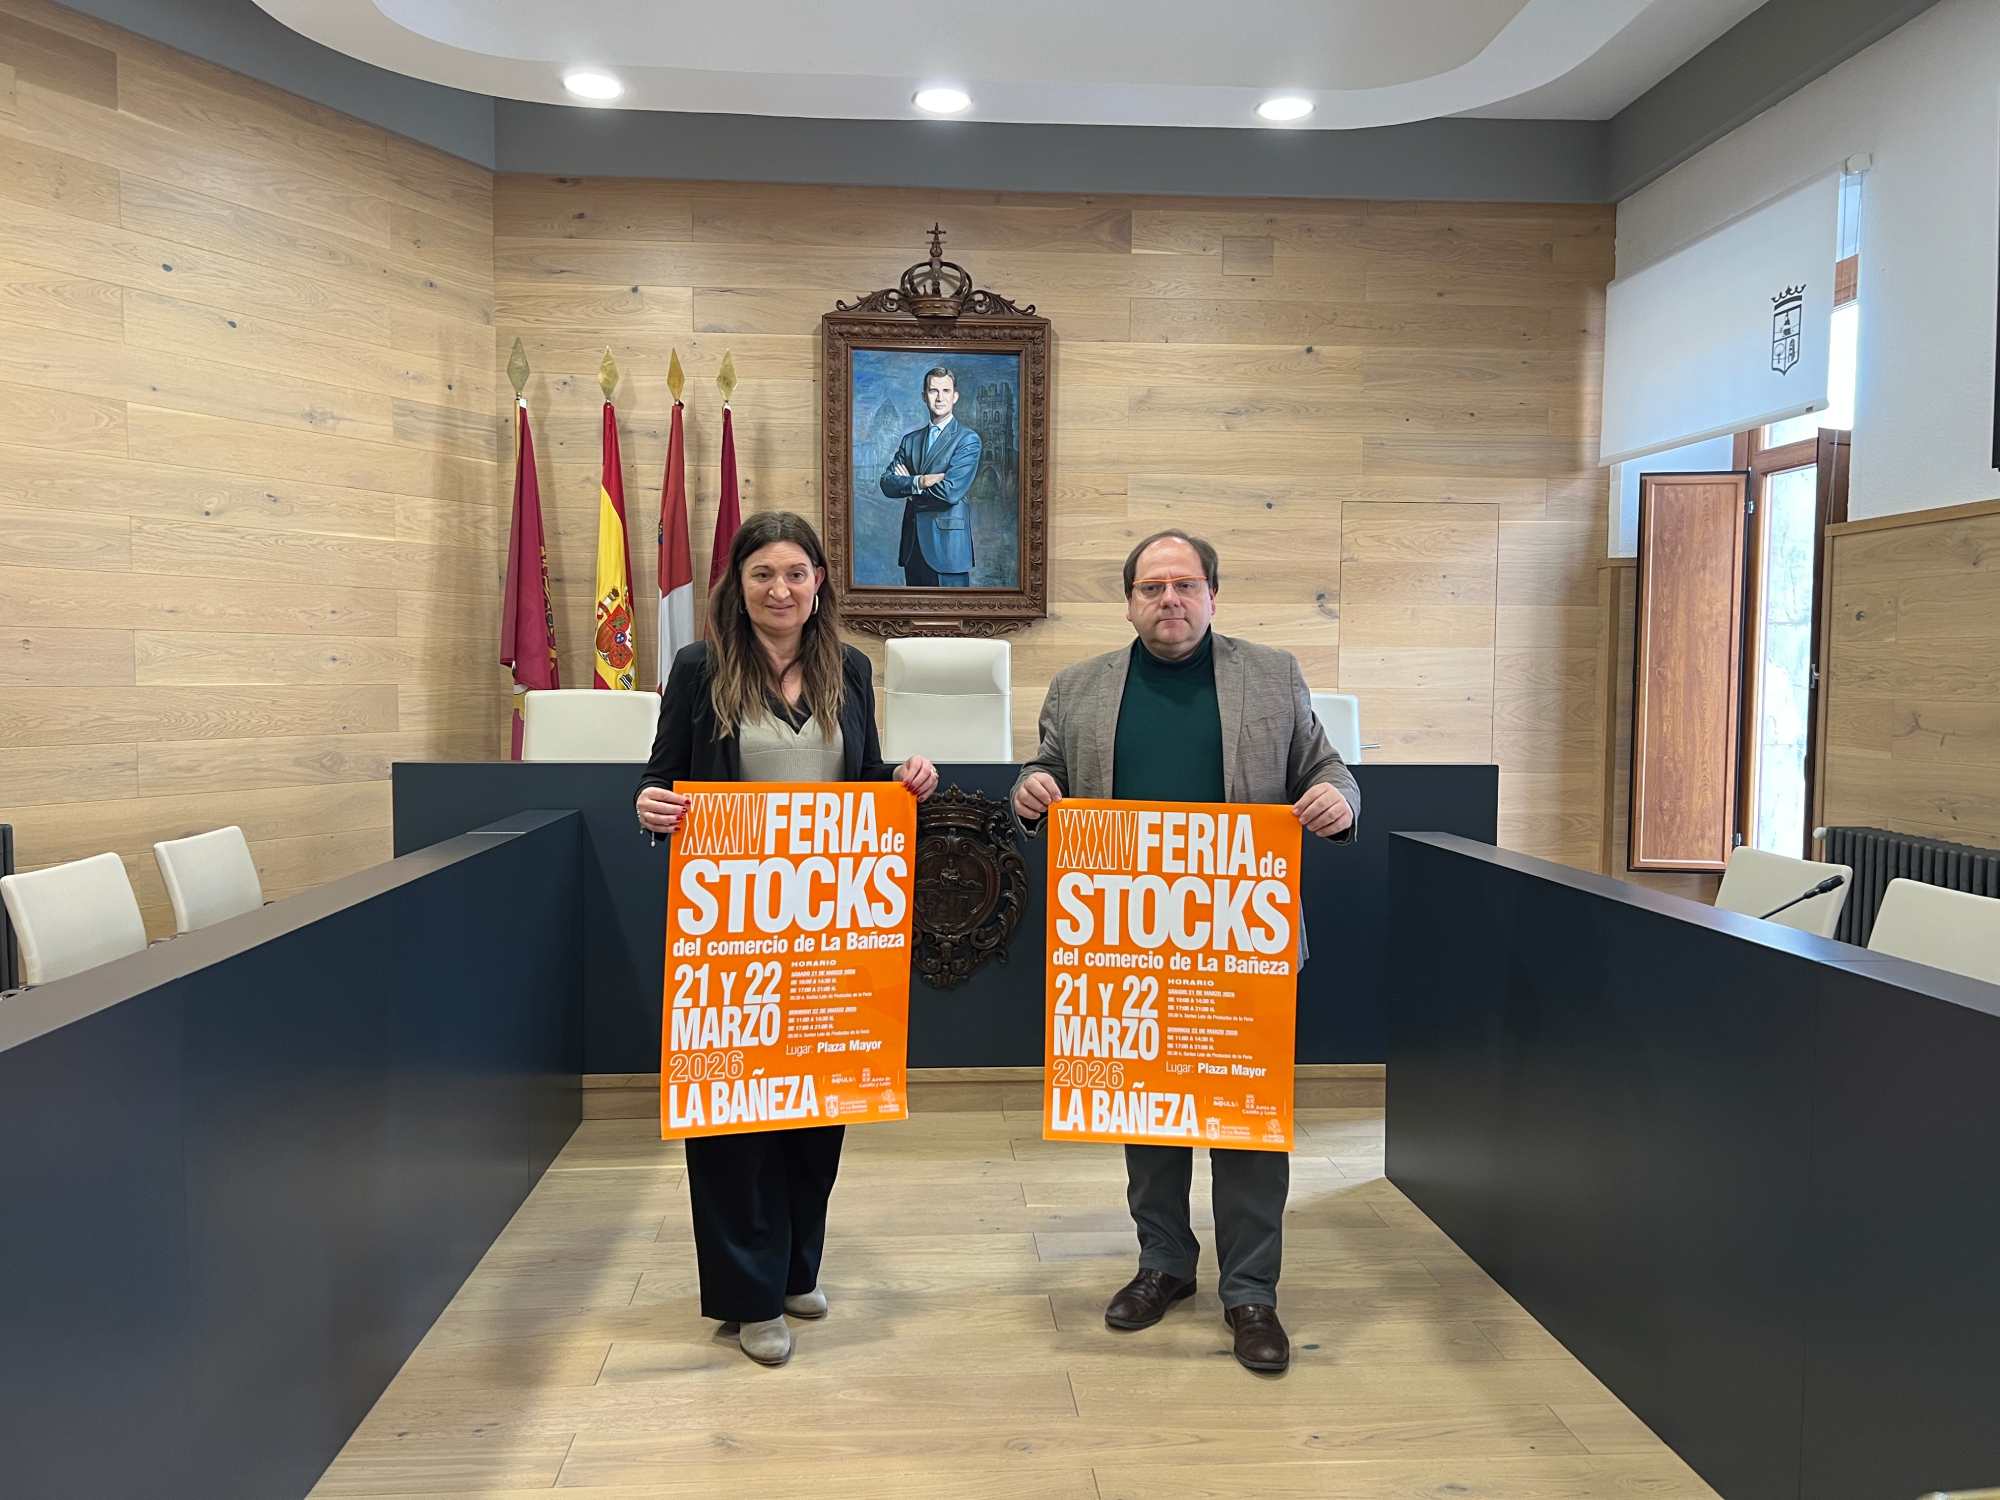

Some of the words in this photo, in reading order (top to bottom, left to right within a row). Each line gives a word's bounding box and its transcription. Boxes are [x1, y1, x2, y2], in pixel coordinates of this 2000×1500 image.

[680, 793, 767, 855] XXXIV
[764, 792, 878, 854] FERIA
[881, 828, 904, 853] de
[1056, 808, 1138, 870] XXXIV
[1137, 811, 1257, 876] FERIA
[1259, 851, 1287, 878] de
[677, 855, 908, 935] STOCKS
[1056, 872, 1291, 954] STOCKS
[673, 938, 700, 957] del
[707, 936, 788, 955] comercio
[794, 934, 815, 952] de
[821, 934, 840, 951] La
[847, 931, 904, 950] Bañeza
[1053, 948, 1079, 966] del
[1085, 951, 1164, 970] comercio
[1170, 952, 1191, 971] de
[1198, 954, 1218, 972] La
[1224, 955, 1289, 976] Bañeza
[674, 963, 710, 1007] 21
[721, 971, 736, 1005] Y
[744, 960, 783, 1005] 22
[1055, 972, 1087, 1015] 21
[1098, 982, 1114, 1017] Y
[1122, 975, 1159, 1018] 22
[1168, 978, 1215, 987] HORARIO
[671, 1003, 781, 1051] MARZO
[817, 1041, 846, 1053] Plaza
[849, 1039, 882, 1053] Mayor
[1053, 1015, 1160, 1061] MARZO
[669, 1051, 744, 1083] 2026
[1053, 1059, 1124, 1088] 2026
[1198, 1062, 1228, 1075] Plaza
[1231, 1063, 1266, 1078] Mayor
[669, 1081, 705, 1128] LA
[711, 1068, 819, 1126] BAÑEZA
[1051, 1087, 1086, 1132] LA
[1091, 1081, 1200, 1137] BAÑEZA
